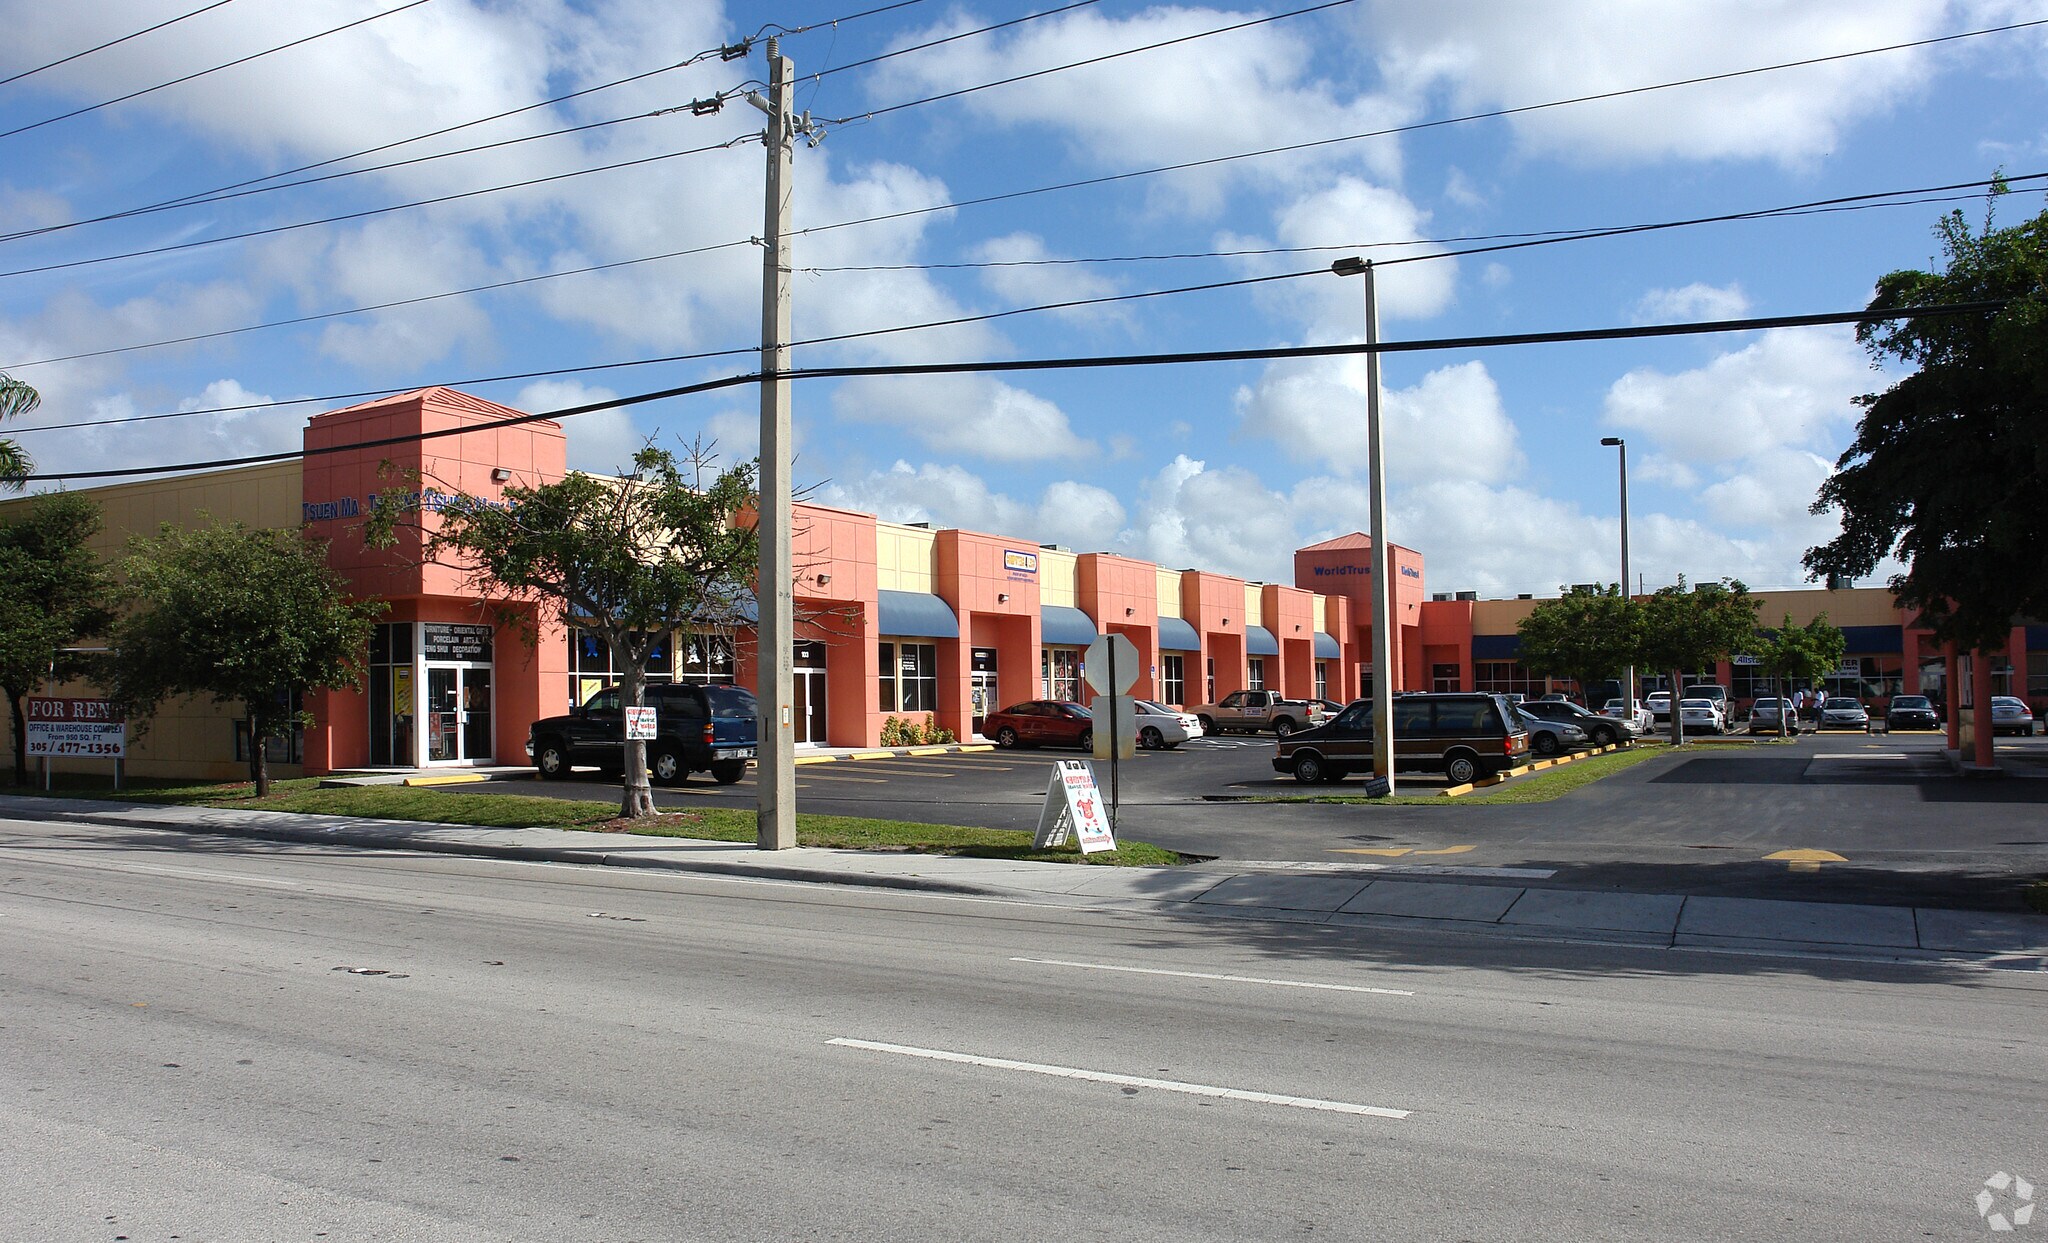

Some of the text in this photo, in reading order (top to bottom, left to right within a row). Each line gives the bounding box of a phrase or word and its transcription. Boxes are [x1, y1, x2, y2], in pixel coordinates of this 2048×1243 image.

[302, 501, 340, 521] TSUEN
[342, 496, 359, 517] MA
[1314, 565, 1371, 576] WorldTrus
[433, 635, 459, 643] PORCELAIN
[30, 701, 115, 719] FOR REN
[29, 724, 49, 732] OFFICE
[56, 724, 92, 732] WAREHOUSE
[93, 724, 123, 734] COMPLEX
[48, 733, 65, 741] From
[66, 733, 78, 741] 950
[30, 742, 47, 752] 305
[57, 742, 121, 754] 477-1356
